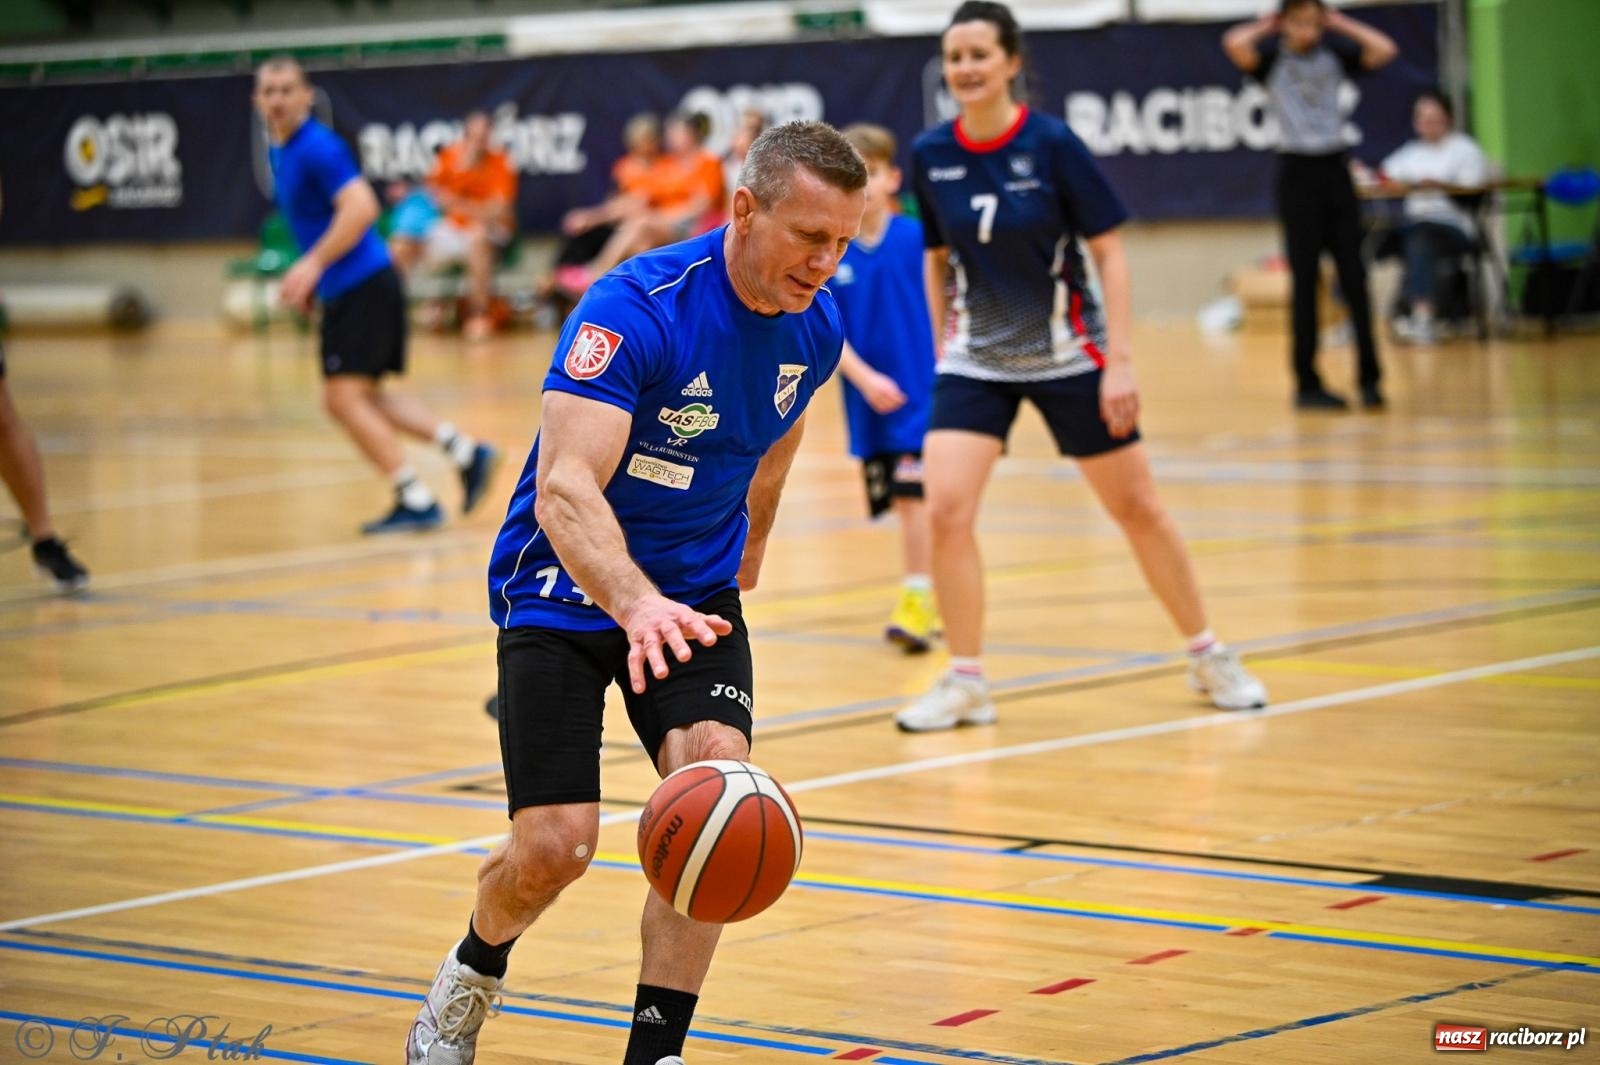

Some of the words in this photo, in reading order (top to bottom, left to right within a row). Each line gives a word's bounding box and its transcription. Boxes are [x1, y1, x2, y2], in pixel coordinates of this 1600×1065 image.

[970, 193, 998, 244] 7
[680, 387, 713, 397] adidas
[658, 446, 700, 463] RUBINSTEIN
[634, 460, 690, 482] WAGTECH
[651, 814, 684, 880] molten
